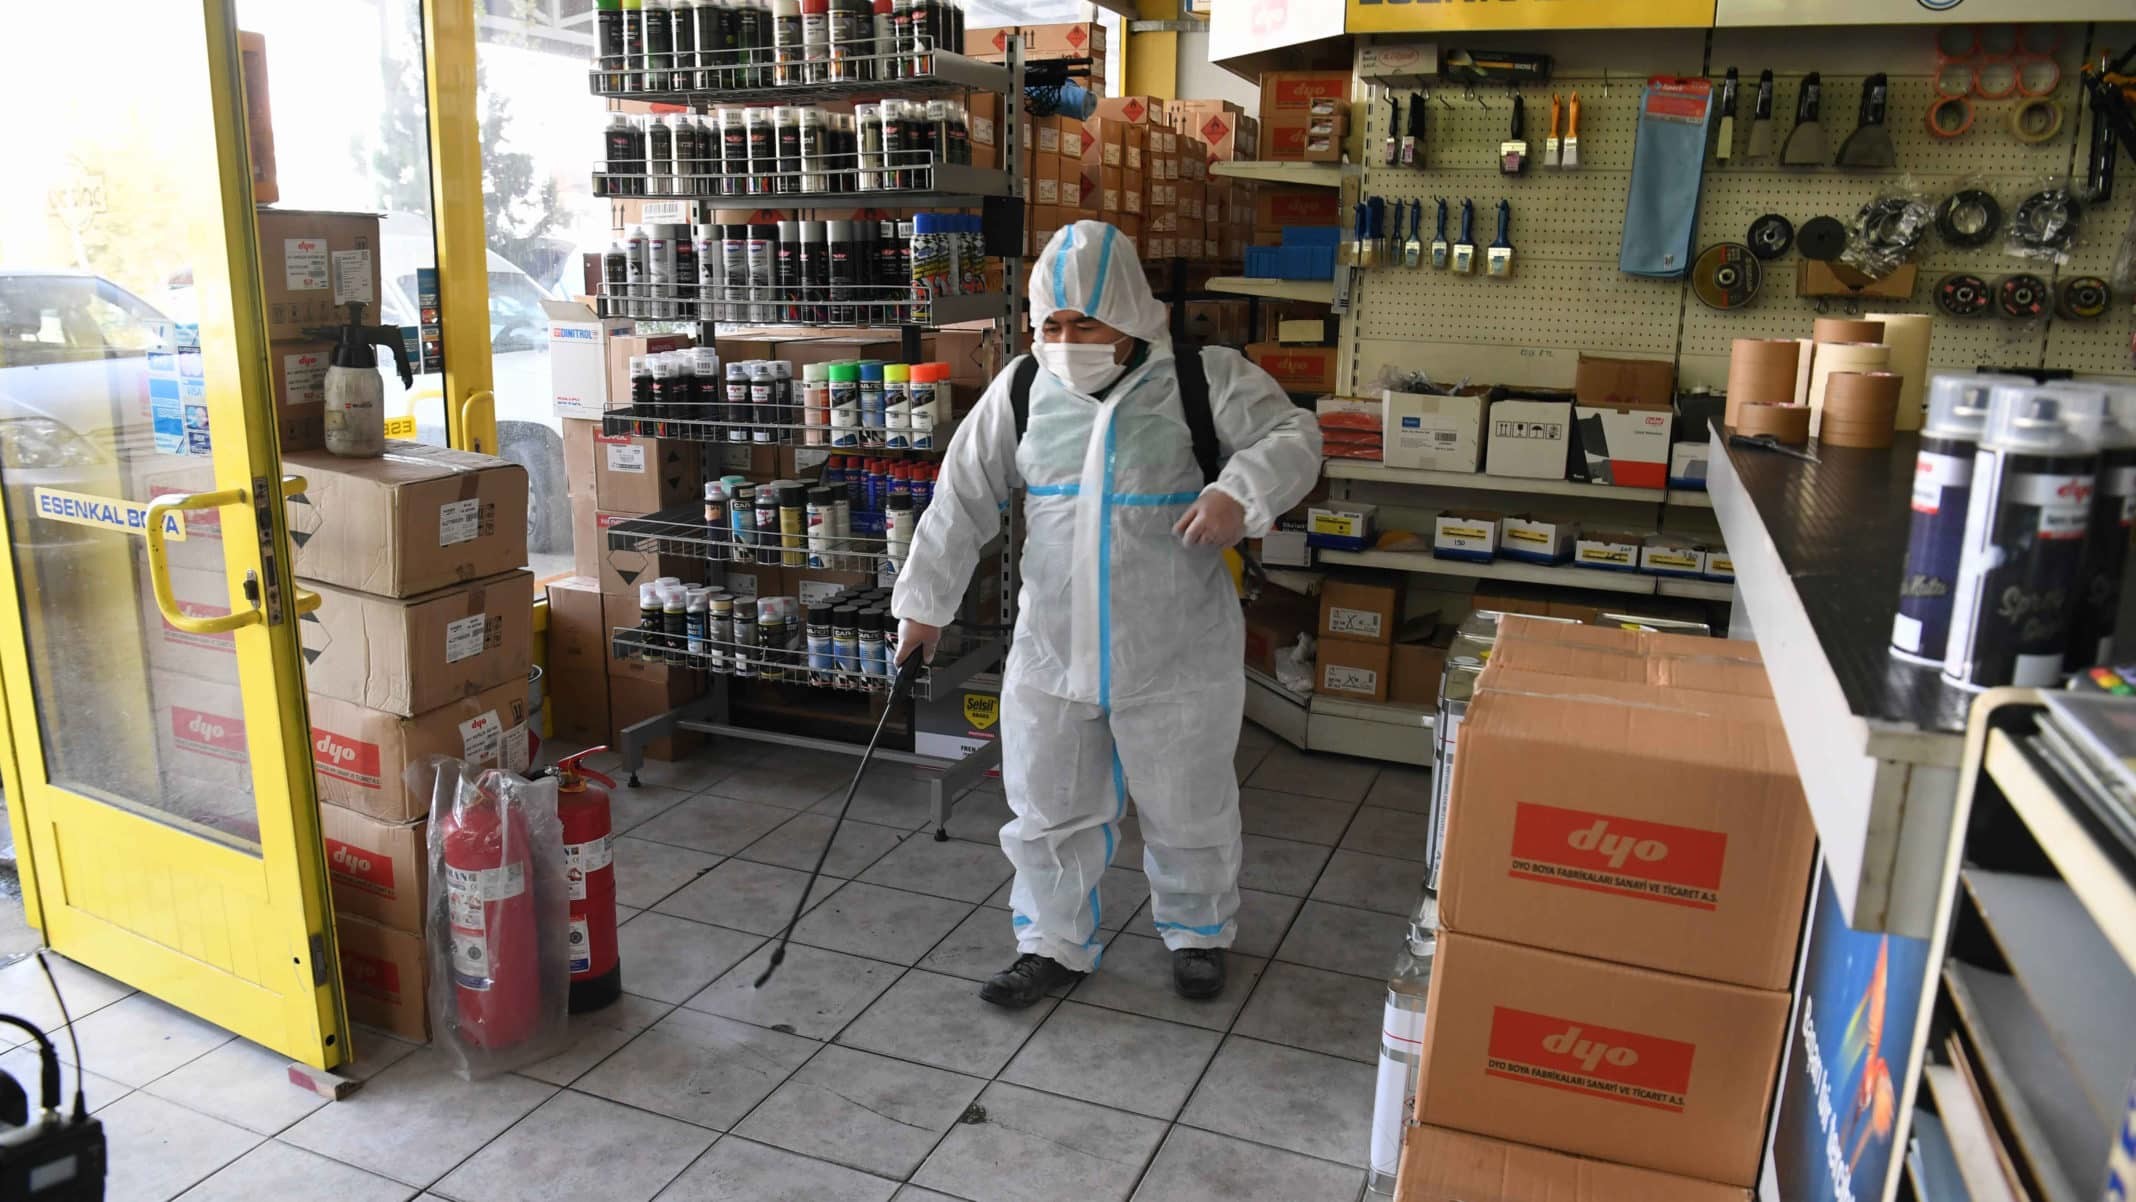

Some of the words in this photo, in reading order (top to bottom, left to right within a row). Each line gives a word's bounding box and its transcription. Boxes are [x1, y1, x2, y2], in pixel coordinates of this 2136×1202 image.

[40, 495, 124, 526] ESENKAL
[189, 715, 224, 741] dyo
[471, 717, 487, 730] dyo
[317, 735, 356, 764] dyo
[1567, 819, 1669, 869] dyo
[333, 846, 372, 874] dyo
[1512, 859, 1530, 871] DYO
[1532, 862, 1555, 875] BOYA
[1649, 882, 1660, 893] VE
[1542, 1025, 1639, 1072] dyo
[1488, 1058, 1506, 1071] DYO
[1507, 1062, 1530, 1074] BOYA
[1619, 1085, 1631, 1096] VE
